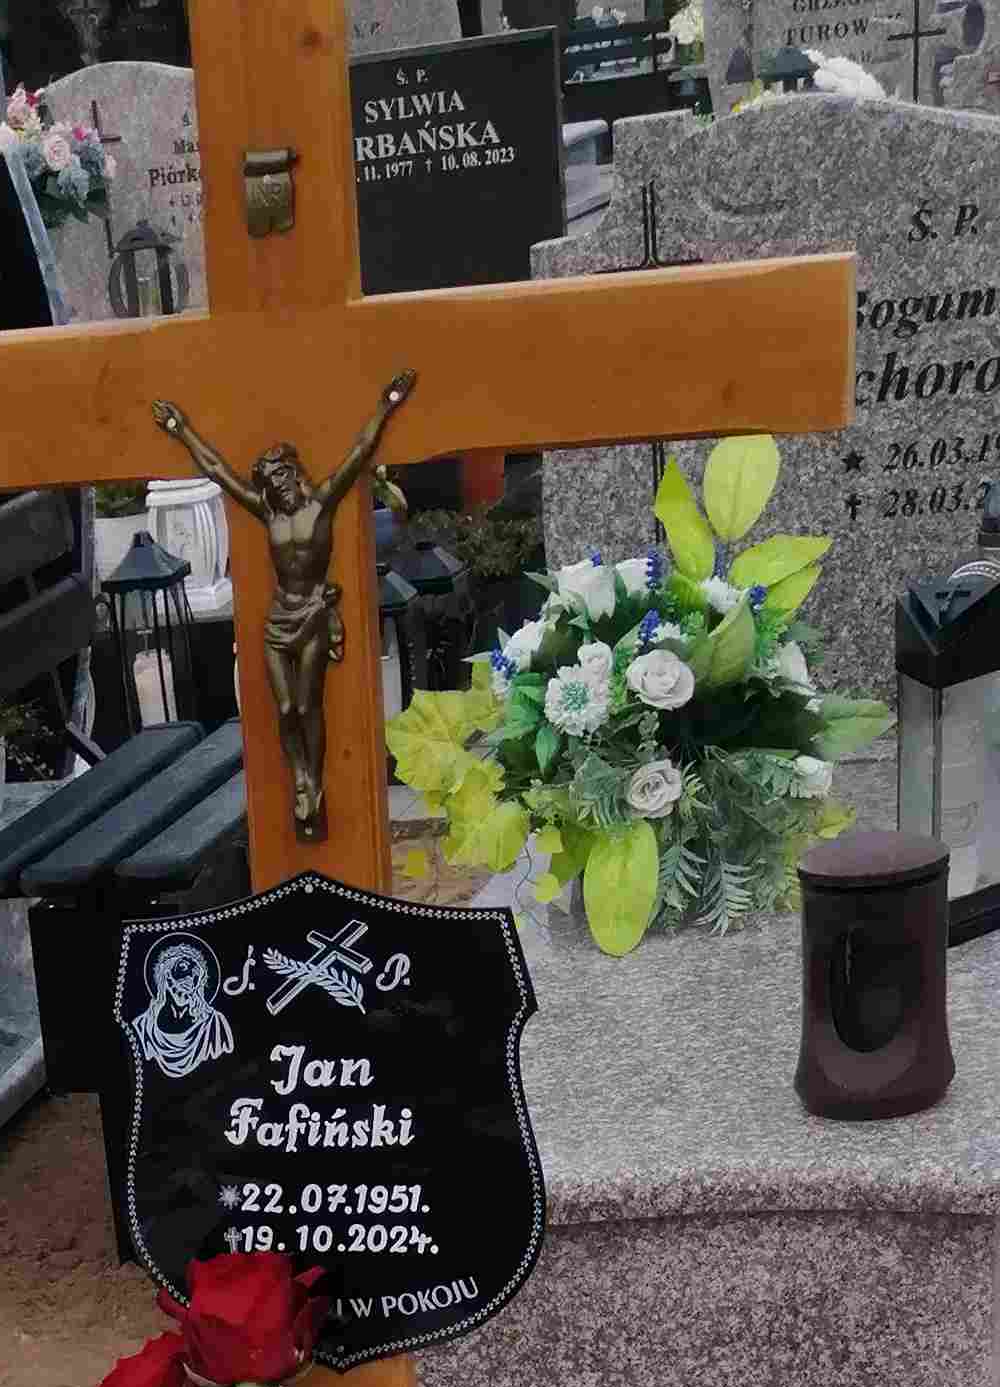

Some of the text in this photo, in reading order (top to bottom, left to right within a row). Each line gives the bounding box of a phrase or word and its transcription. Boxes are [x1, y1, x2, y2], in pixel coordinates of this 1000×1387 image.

[364, 90, 465, 124] SYLWIA
[354, 120, 501, 161] RBAŃSKA
[954, 204, 978, 236] P.
[270, 1044, 375, 1096] Jan
[223, 1098, 416, 1153] Fafiński
[381, 1275, 481, 1319] POKOJU
